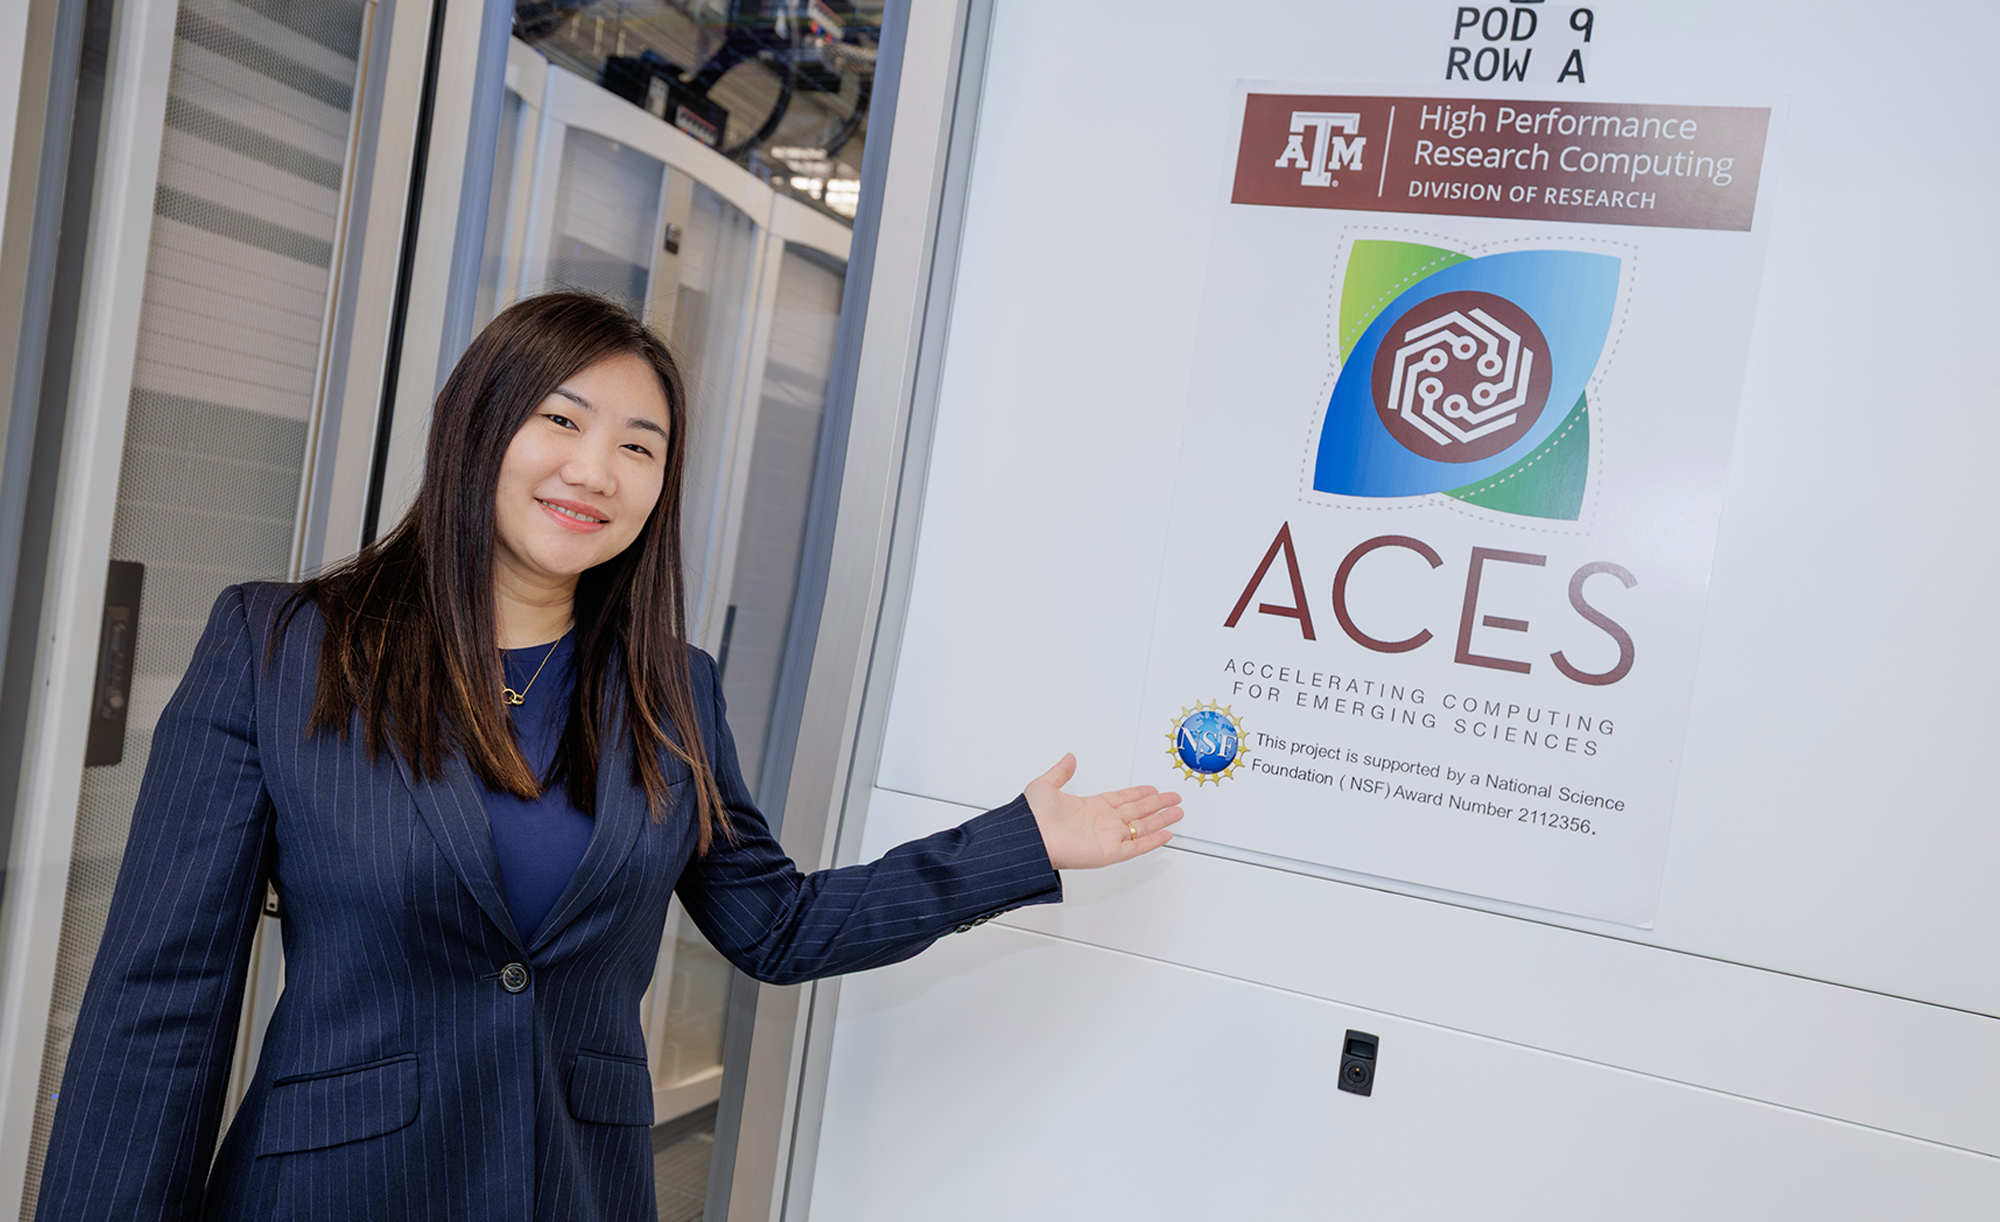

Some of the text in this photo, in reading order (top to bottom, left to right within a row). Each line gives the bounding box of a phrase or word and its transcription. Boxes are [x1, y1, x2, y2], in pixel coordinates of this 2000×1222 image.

[1453, 6, 1594, 43] POD 9
[1445, 46, 1586, 84] ROW A
[1420, 104, 1698, 140] High Performance
[1414, 139, 1735, 187] Research Computing
[1408, 180, 1656, 210] DIVISION OF RESEARCH
[1223, 520, 1639, 687] ACES
[1224, 658, 1615, 736] ACCELERATING COMPUTING
[1232, 681, 1598, 756] FOR EMERGING SCIENCES
[1178, 726, 1238, 759] NSF
[1256, 732, 1626, 812] This project is supported by a National Science
[1251, 758, 1334, 786] Foundation
[1393, 784, 1444, 806] Award
[1448, 795, 1514, 819] Number
[1518, 807, 1597, 836] 2112356.
